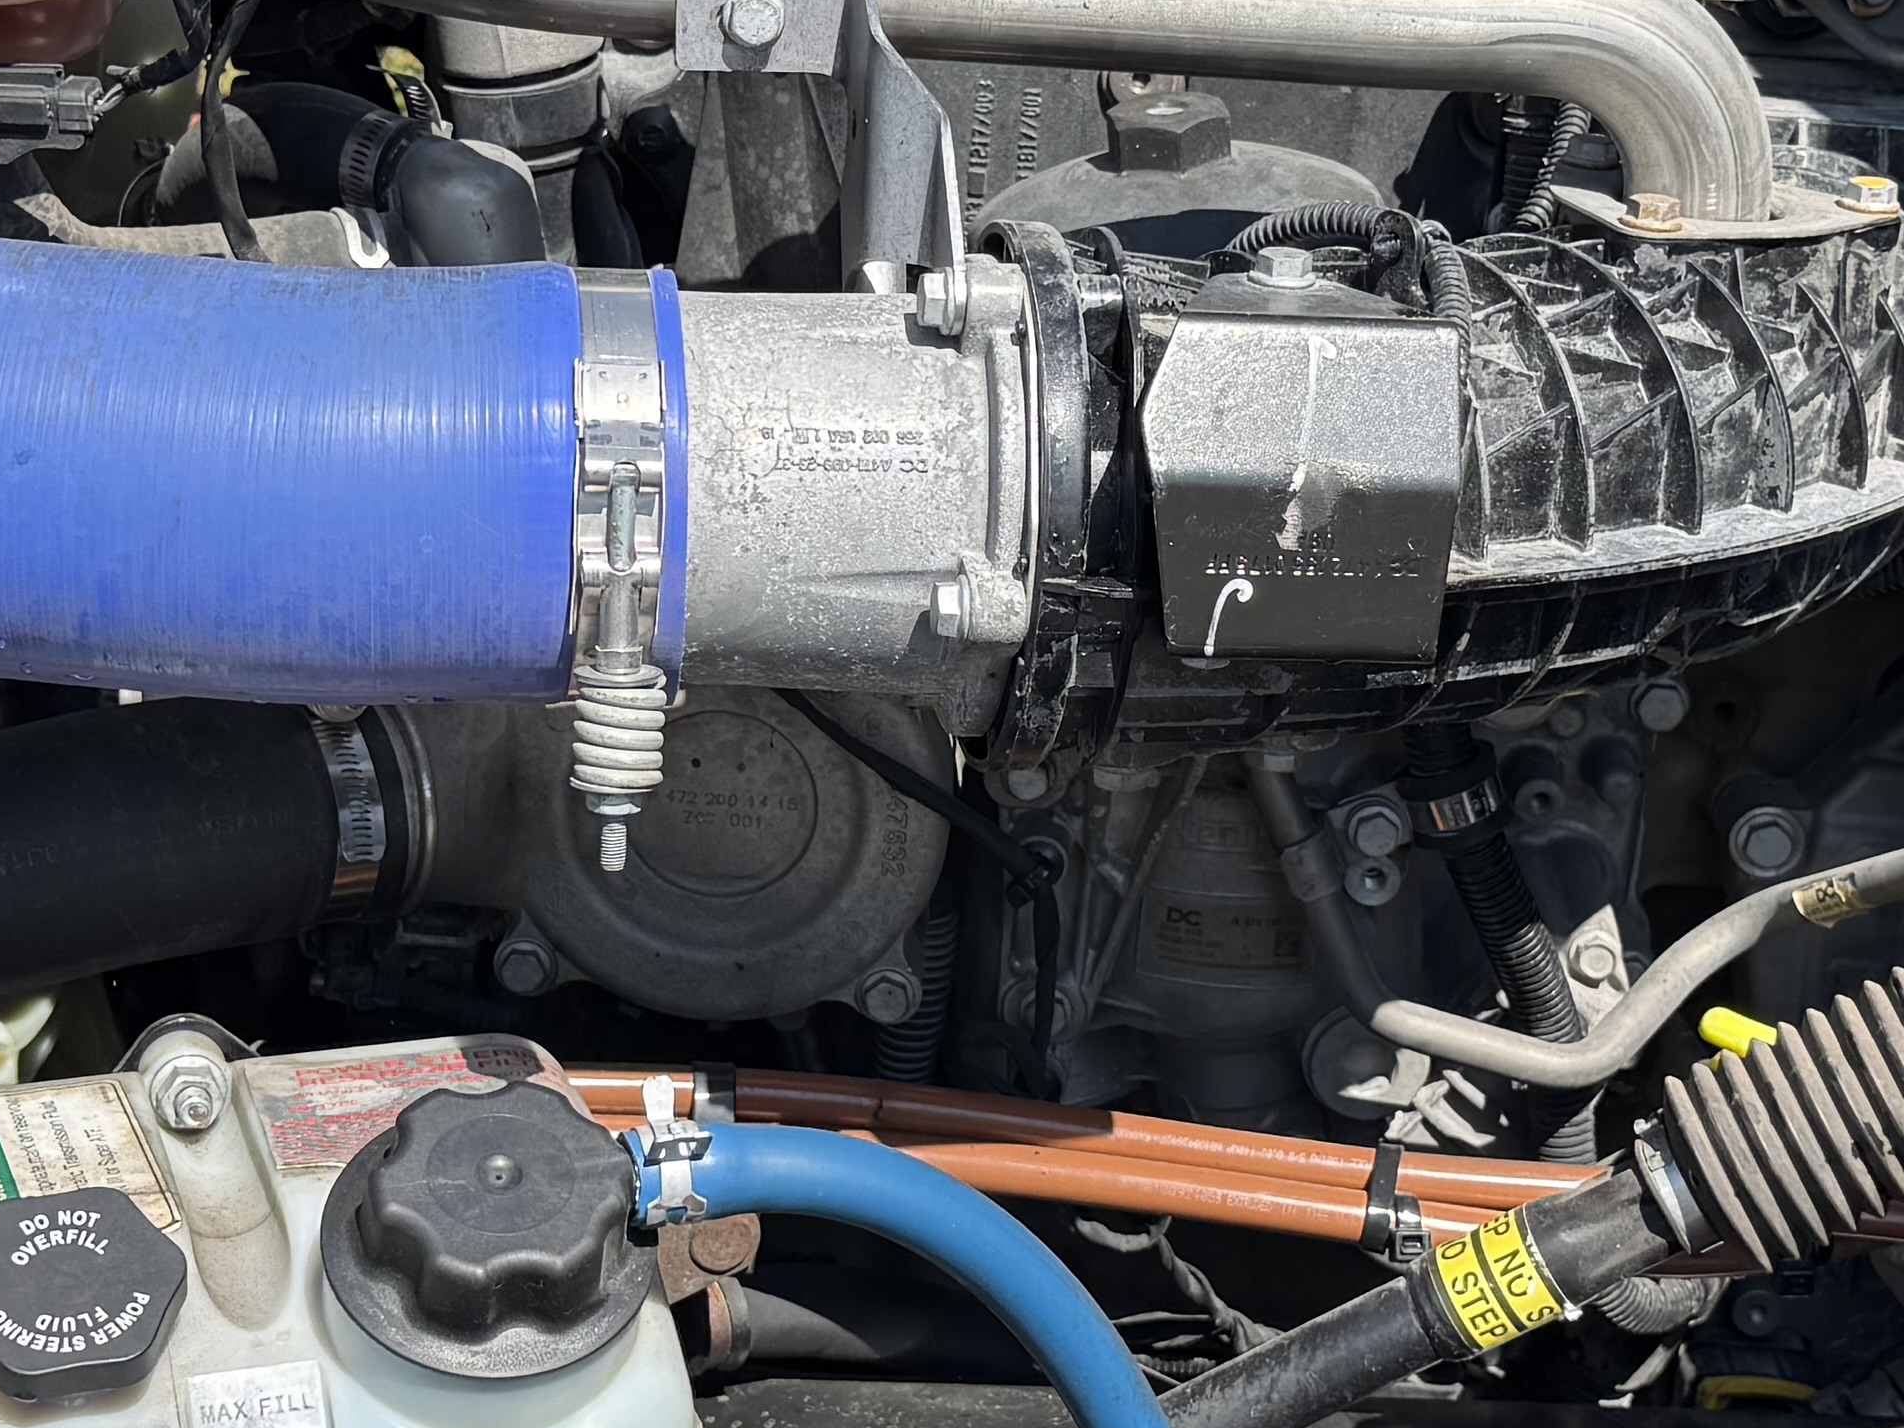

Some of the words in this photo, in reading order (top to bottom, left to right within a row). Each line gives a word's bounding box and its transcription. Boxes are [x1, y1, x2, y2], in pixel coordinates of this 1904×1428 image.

[1166, 905, 1202, 926] DC
[18, 1214, 51, 1236] DO
[57, 1209, 101, 1228] NOT
[10, 1228, 109, 1266] OVERFILL
[1494, 1248, 1533, 1298] NO
[35, 1305, 109, 1333] FLUID
[89, 1291, 151, 1346] POWER
[1451, 1271, 1508, 1337] STEP
[200, 1400, 248, 1423] MAX
[259, 1393, 315, 1417] FILL
